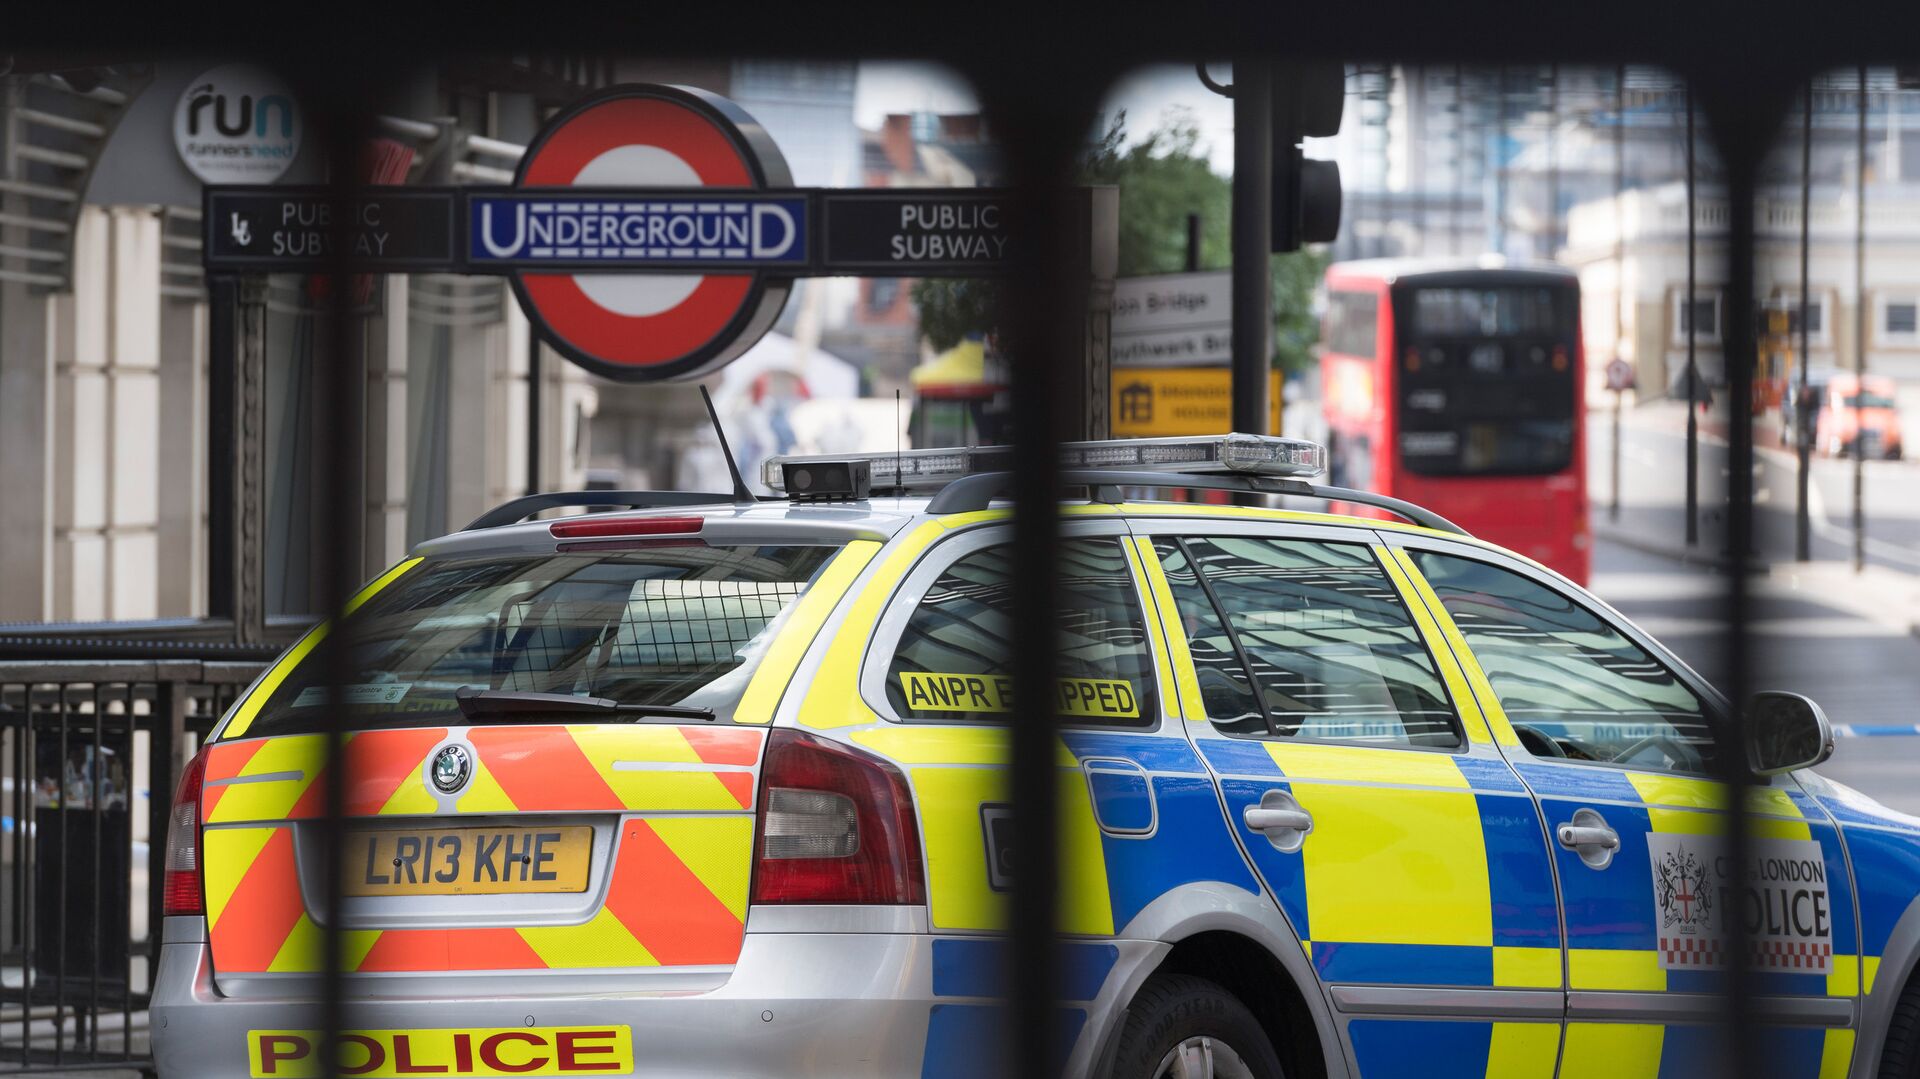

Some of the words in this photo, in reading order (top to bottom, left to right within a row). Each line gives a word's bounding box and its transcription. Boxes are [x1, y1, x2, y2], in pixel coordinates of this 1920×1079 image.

[187, 94, 293, 138] run
[283, 203, 381, 226] PUBIC
[901, 204, 1000, 229] PUBLIC
[272, 231, 389, 256] SUBAY
[482, 203, 796, 258] UNDERGROUND
[890, 234, 1008, 259] SUBWAY
[1146, 291, 1209, 314] Bridge
[911, 676, 992, 707] ANPR
[995, 678, 1134, 713] EIPPED
[365, 835, 463, 885] LR13
[473, 833, 561, 882] KHE
[1759, 858, 1825, 884] LONDON
[259, 1030, 621, 1074] POLICE
